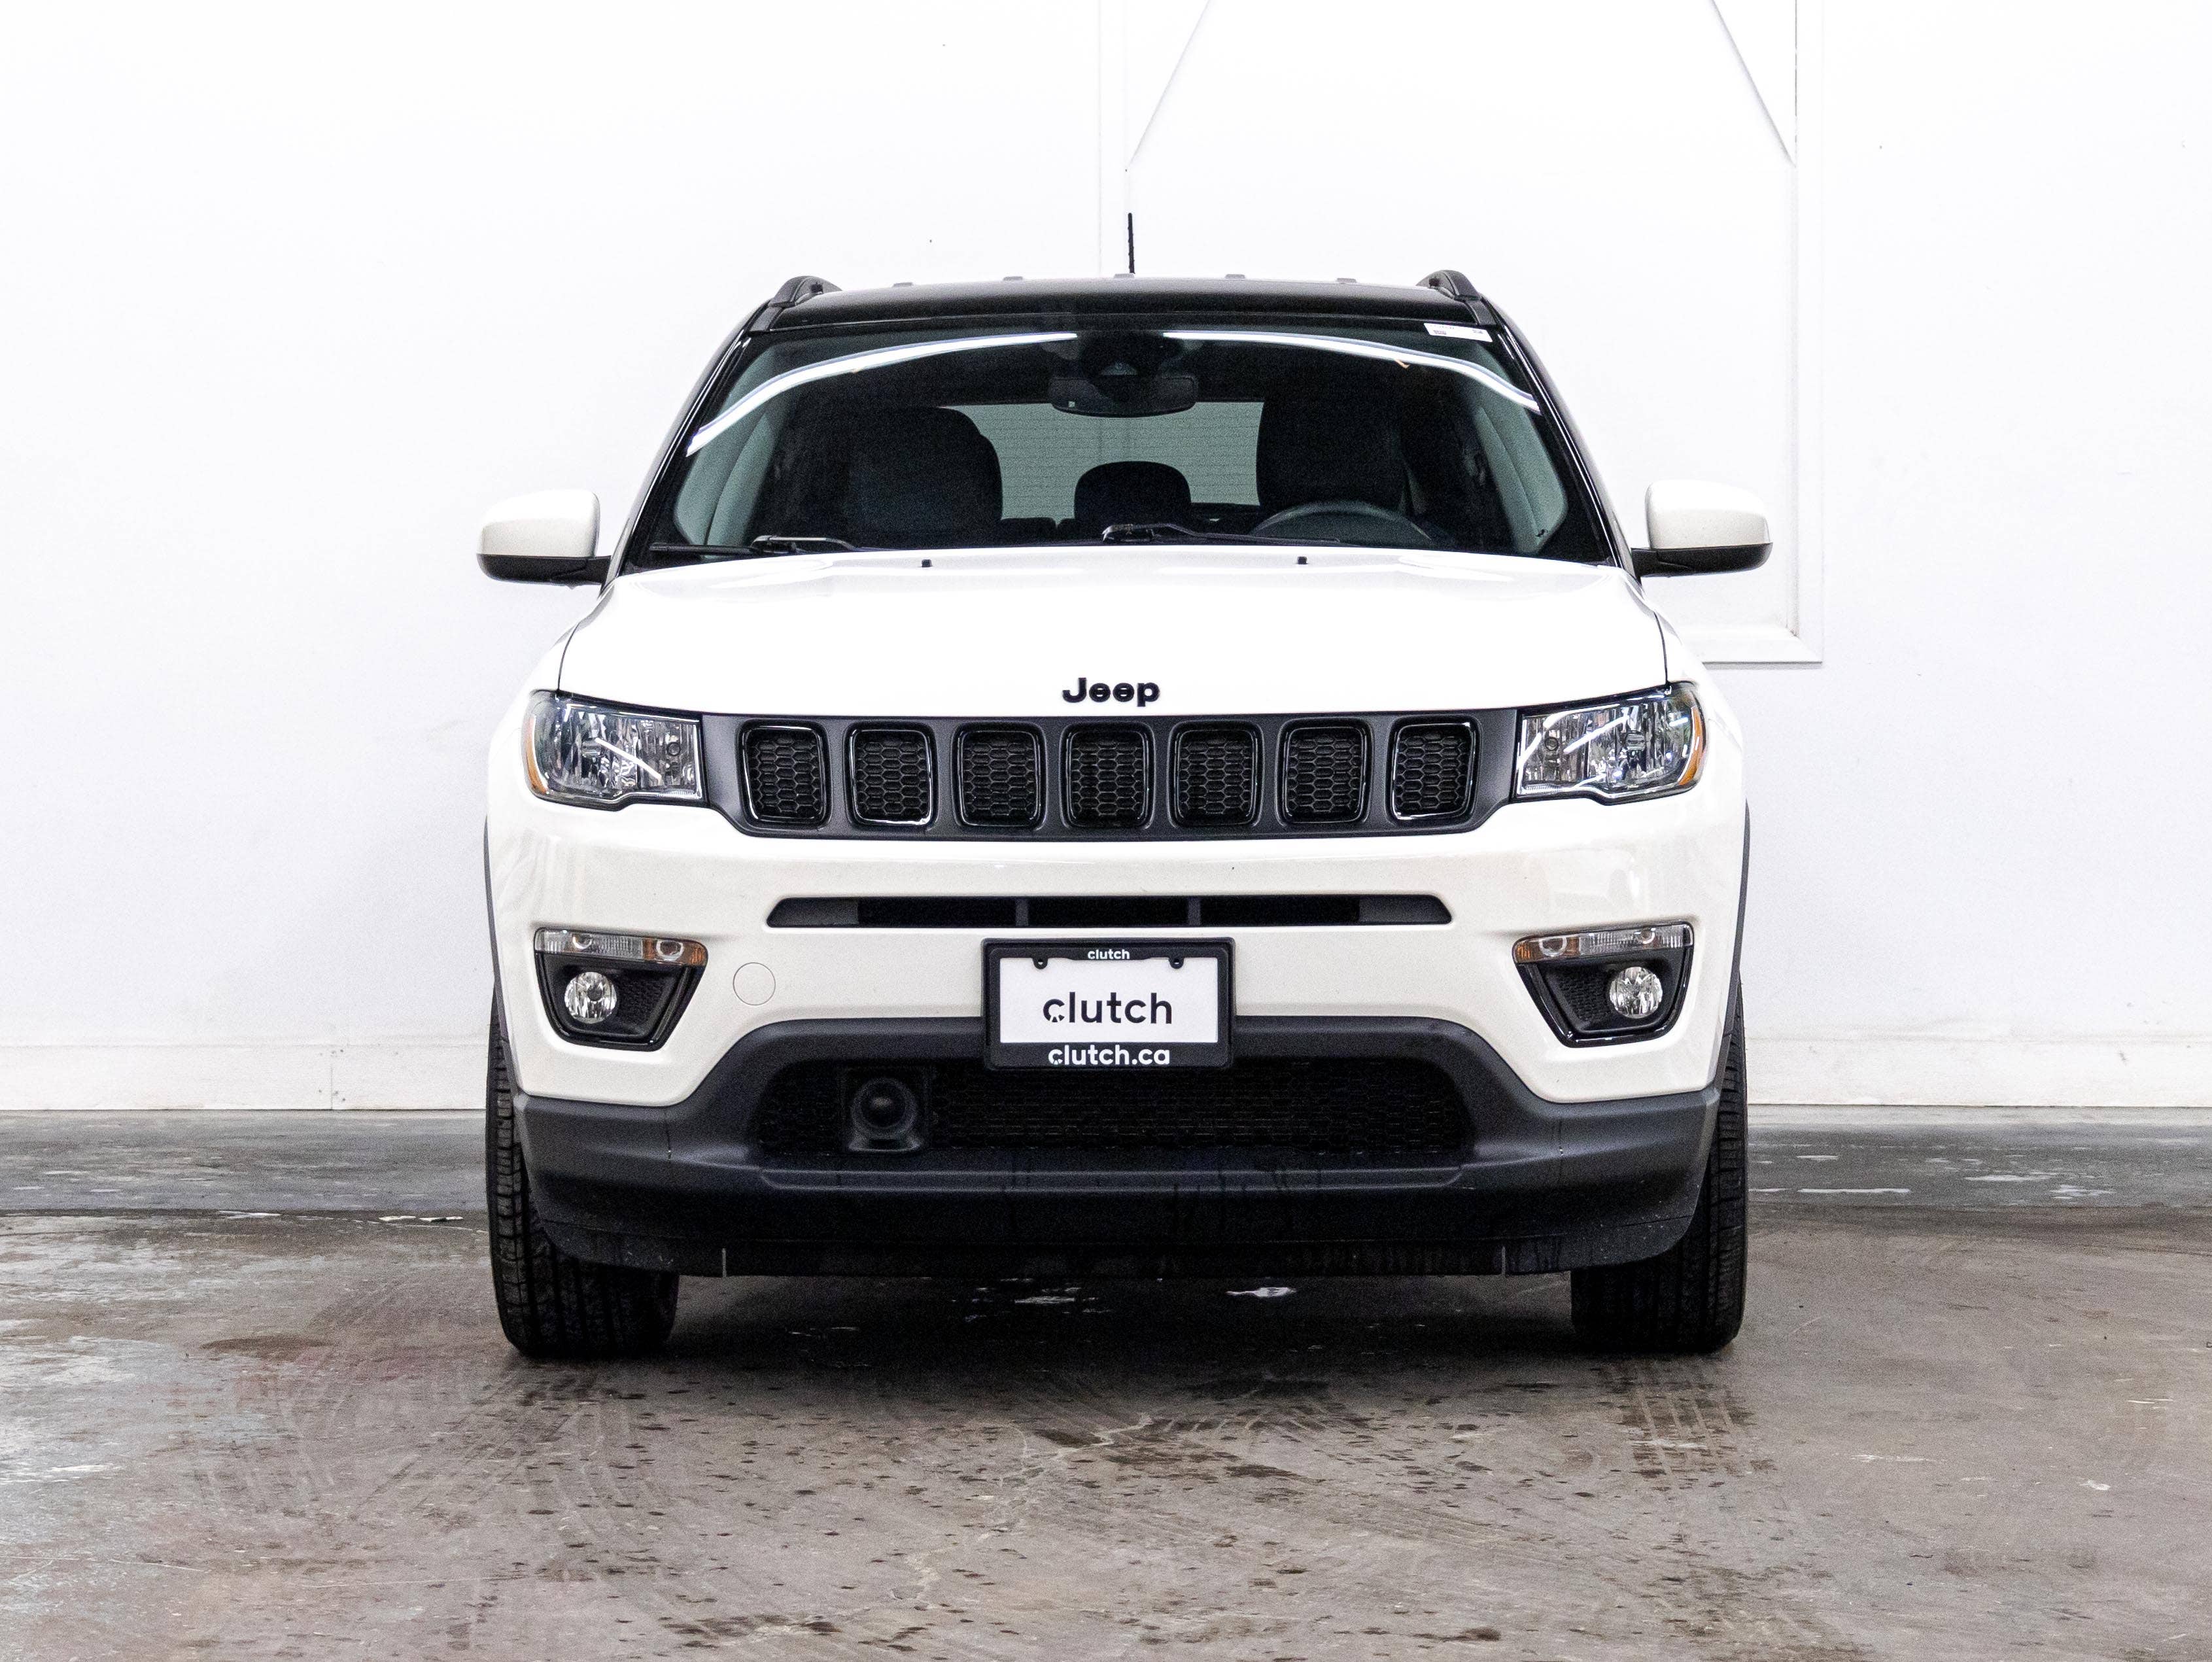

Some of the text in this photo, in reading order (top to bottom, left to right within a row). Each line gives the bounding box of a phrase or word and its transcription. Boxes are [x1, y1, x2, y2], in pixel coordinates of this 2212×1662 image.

[1062, 677, 1160, 707] Jeep
[1087, 948, 1130, 960] clutch
[1043, 992, 1172, 1024] clutch
[1048, 1045, 1170, 1065] clutch.ca
